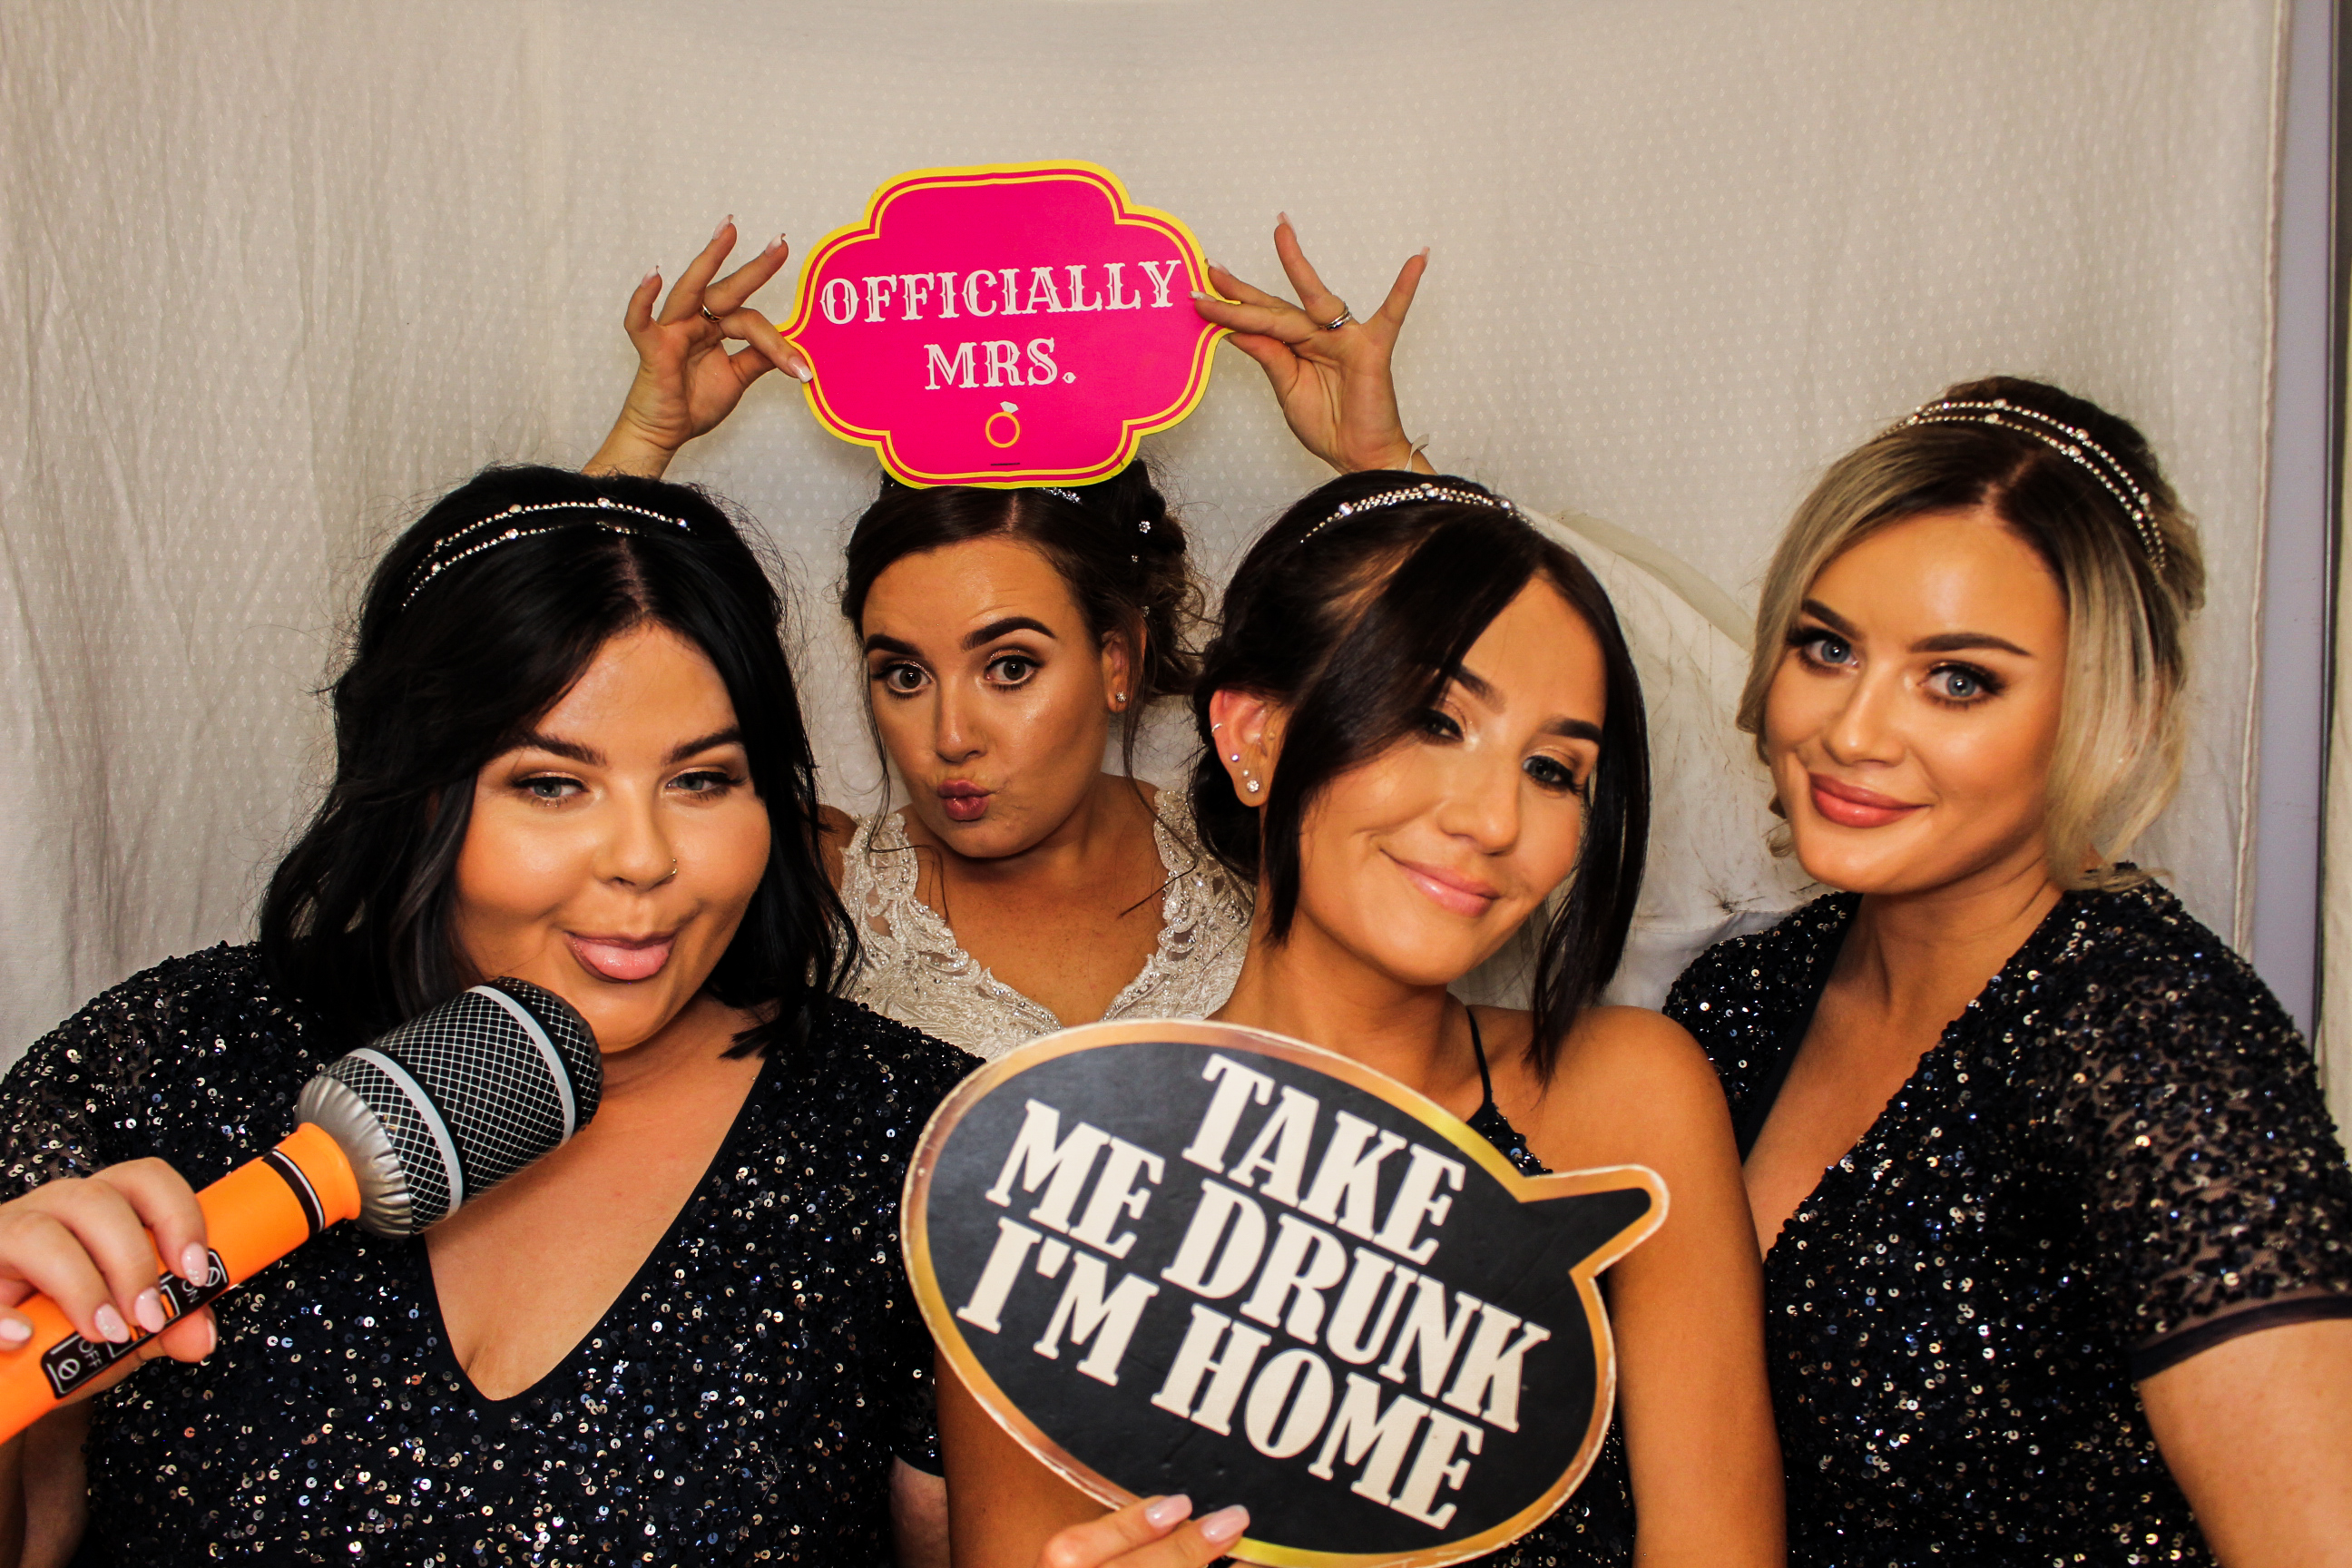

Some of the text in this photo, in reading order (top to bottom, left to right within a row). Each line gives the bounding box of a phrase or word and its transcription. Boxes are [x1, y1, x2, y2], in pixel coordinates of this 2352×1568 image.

[819, 259, 1182, 325] OFFICIALLY
[924, 337, 1077, 390] MRS.
[1181, 1053, 1466, 1265] TAKE
[985, 1097, 1551, 1434] ME DRUNK
[956, 1216, 1485, 1531] I'M HOME
